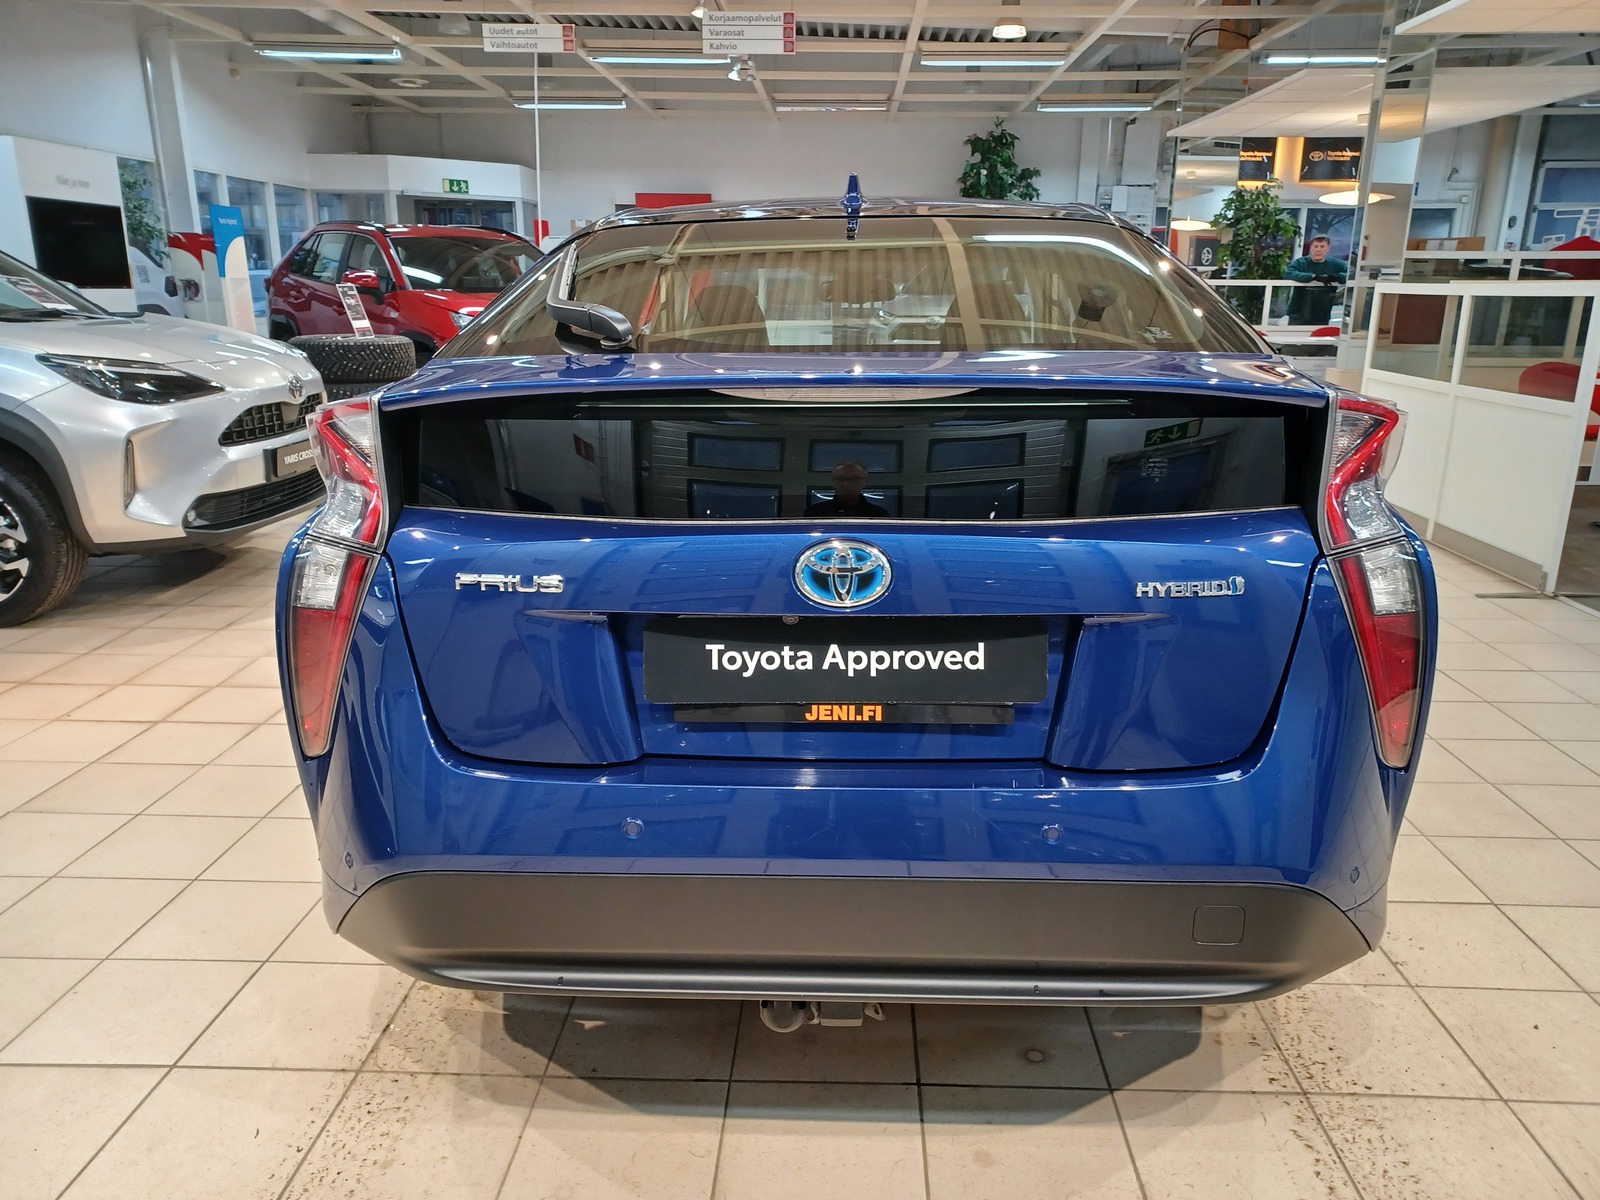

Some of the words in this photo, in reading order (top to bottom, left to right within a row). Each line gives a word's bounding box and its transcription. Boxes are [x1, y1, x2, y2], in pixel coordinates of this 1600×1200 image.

[709, 14, 782, 23] Korjaamopalvelut
[489, 27, 514, 35] Uudet
[516, 27, 538, 35] autot
[709, 28, 744, 36] Varaosat
[489, 41, 538, 49] Vaihtoautot
[709, 42, 738, 50] Kahvio
[284, 453, 299, 464] YARIS
[455, 572, 564, 593] PRIUS
[1136, 580, 1229, 598] HYBRID
[705, 644, 813, 677] Toyota
[822, 642, 985, 677] Approved
[804, 704, 882, 722] JENI.FI
